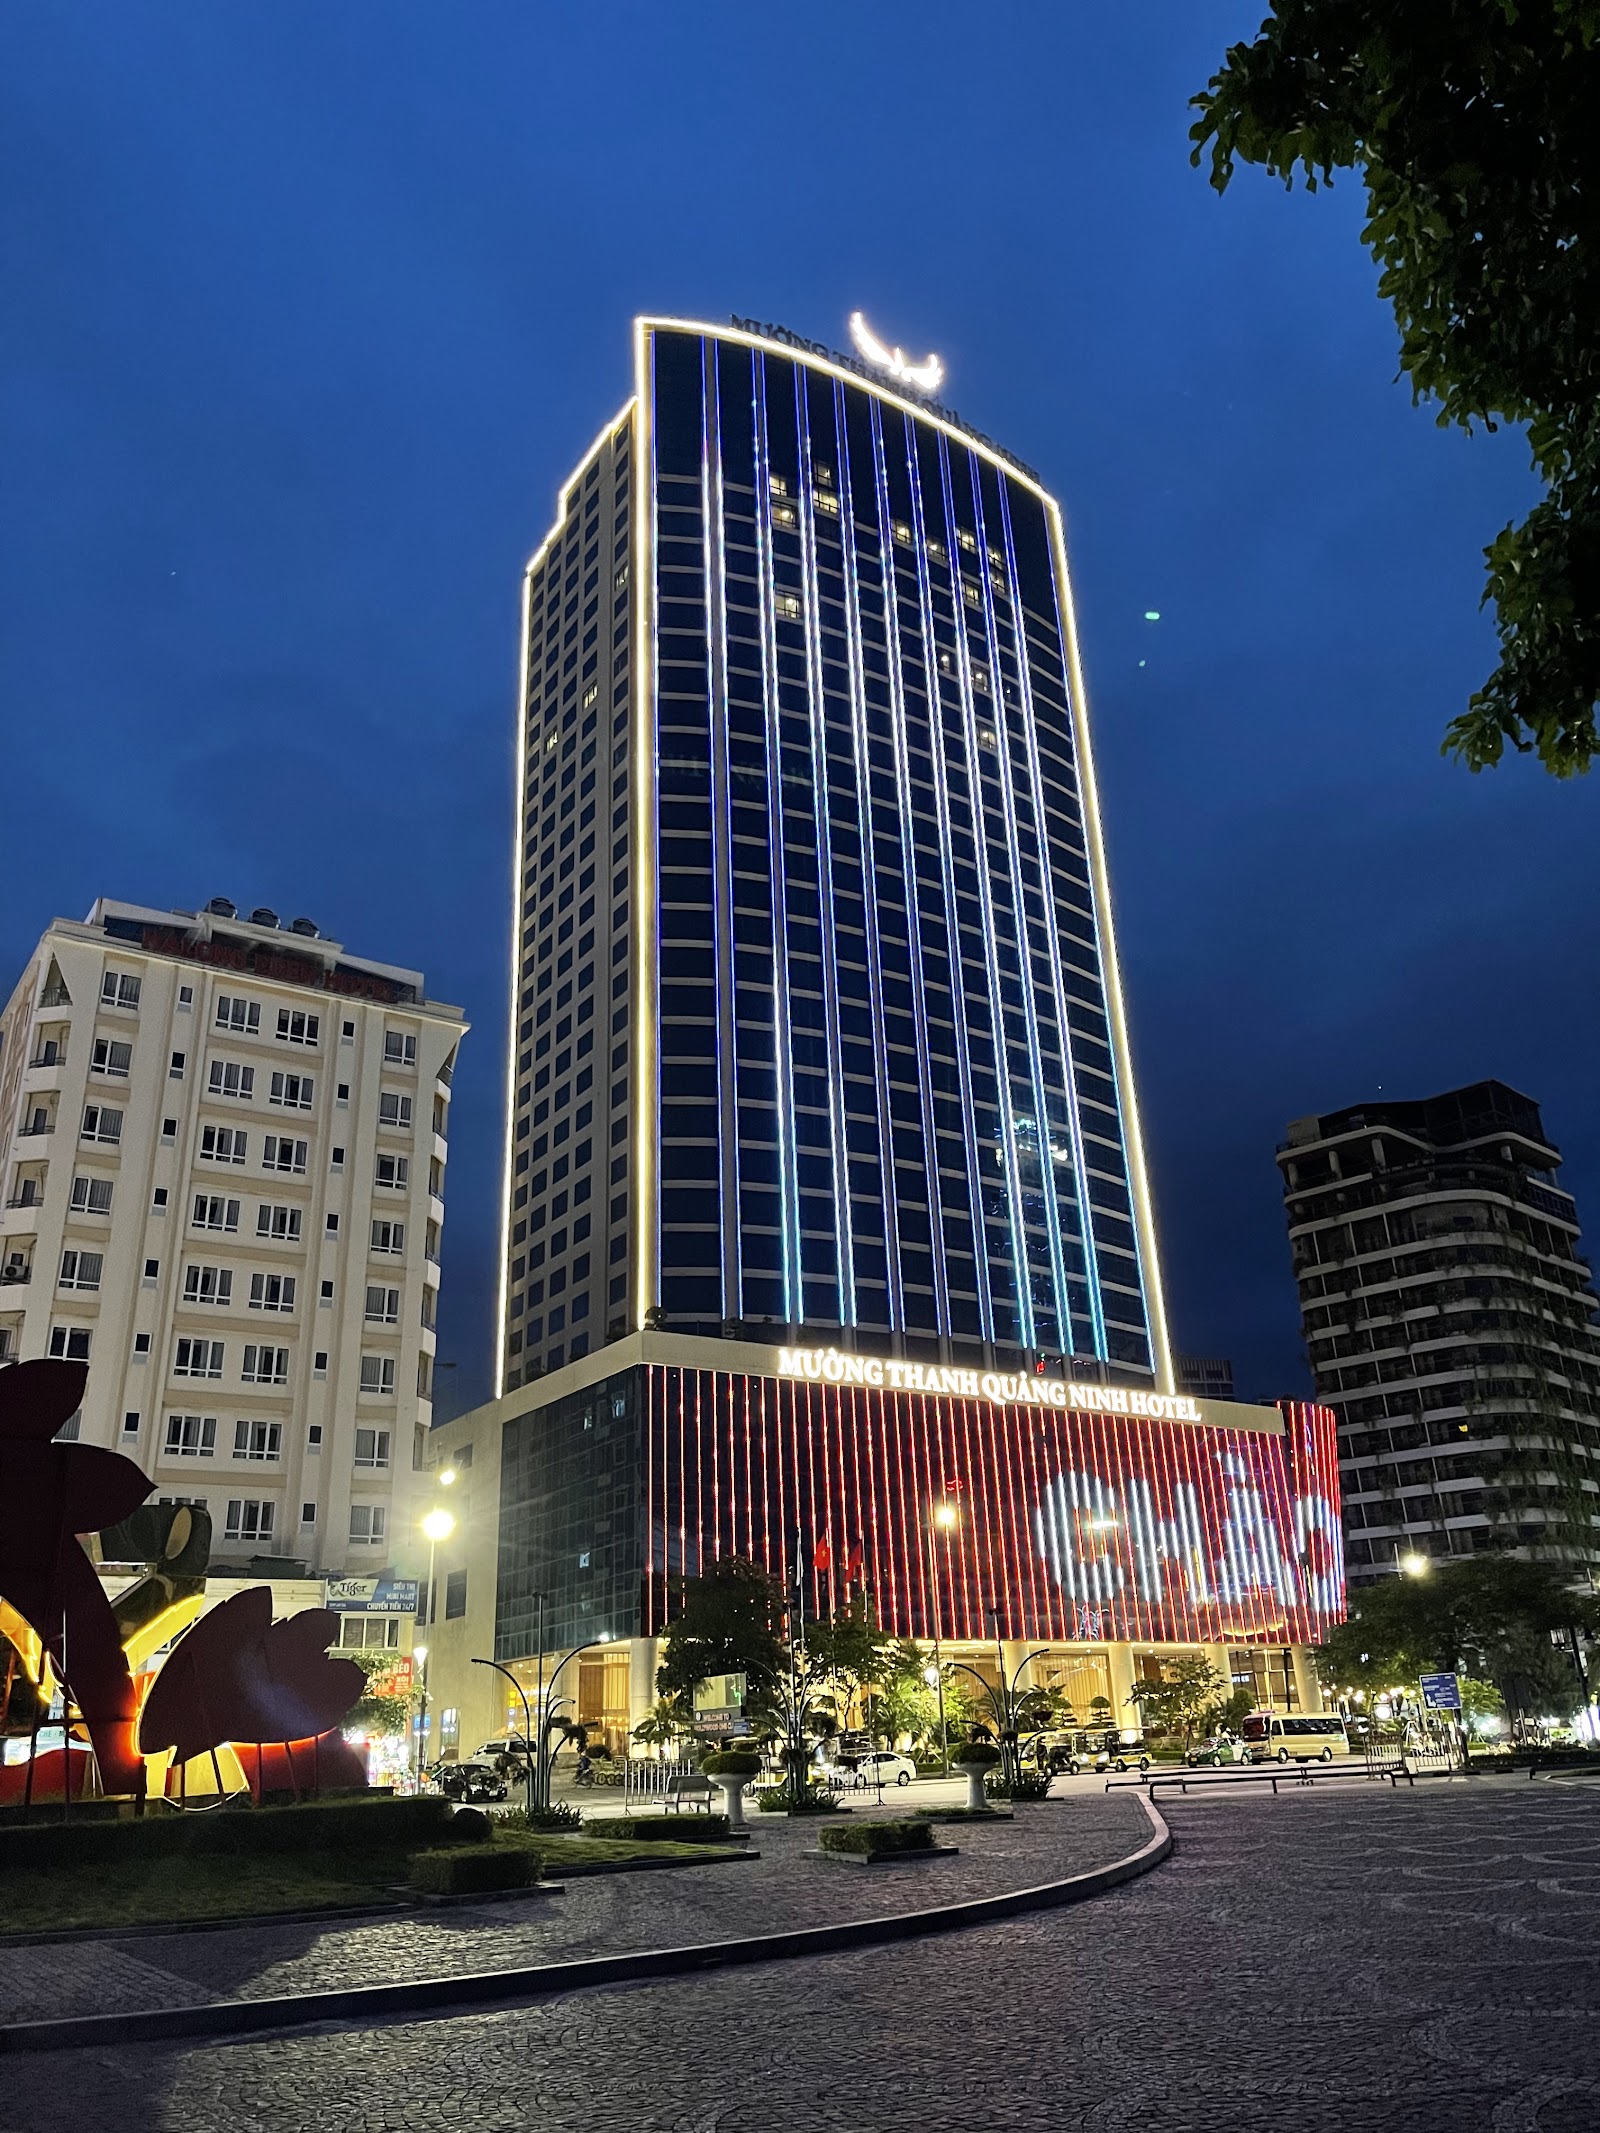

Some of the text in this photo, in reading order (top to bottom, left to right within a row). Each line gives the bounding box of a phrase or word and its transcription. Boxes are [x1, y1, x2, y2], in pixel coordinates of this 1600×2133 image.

[778, 1347, 1203, 1422] MƯỜNG THANH QUẢNG NINH HOTEL
[386, 1592, 415, 1601] MINI MART
